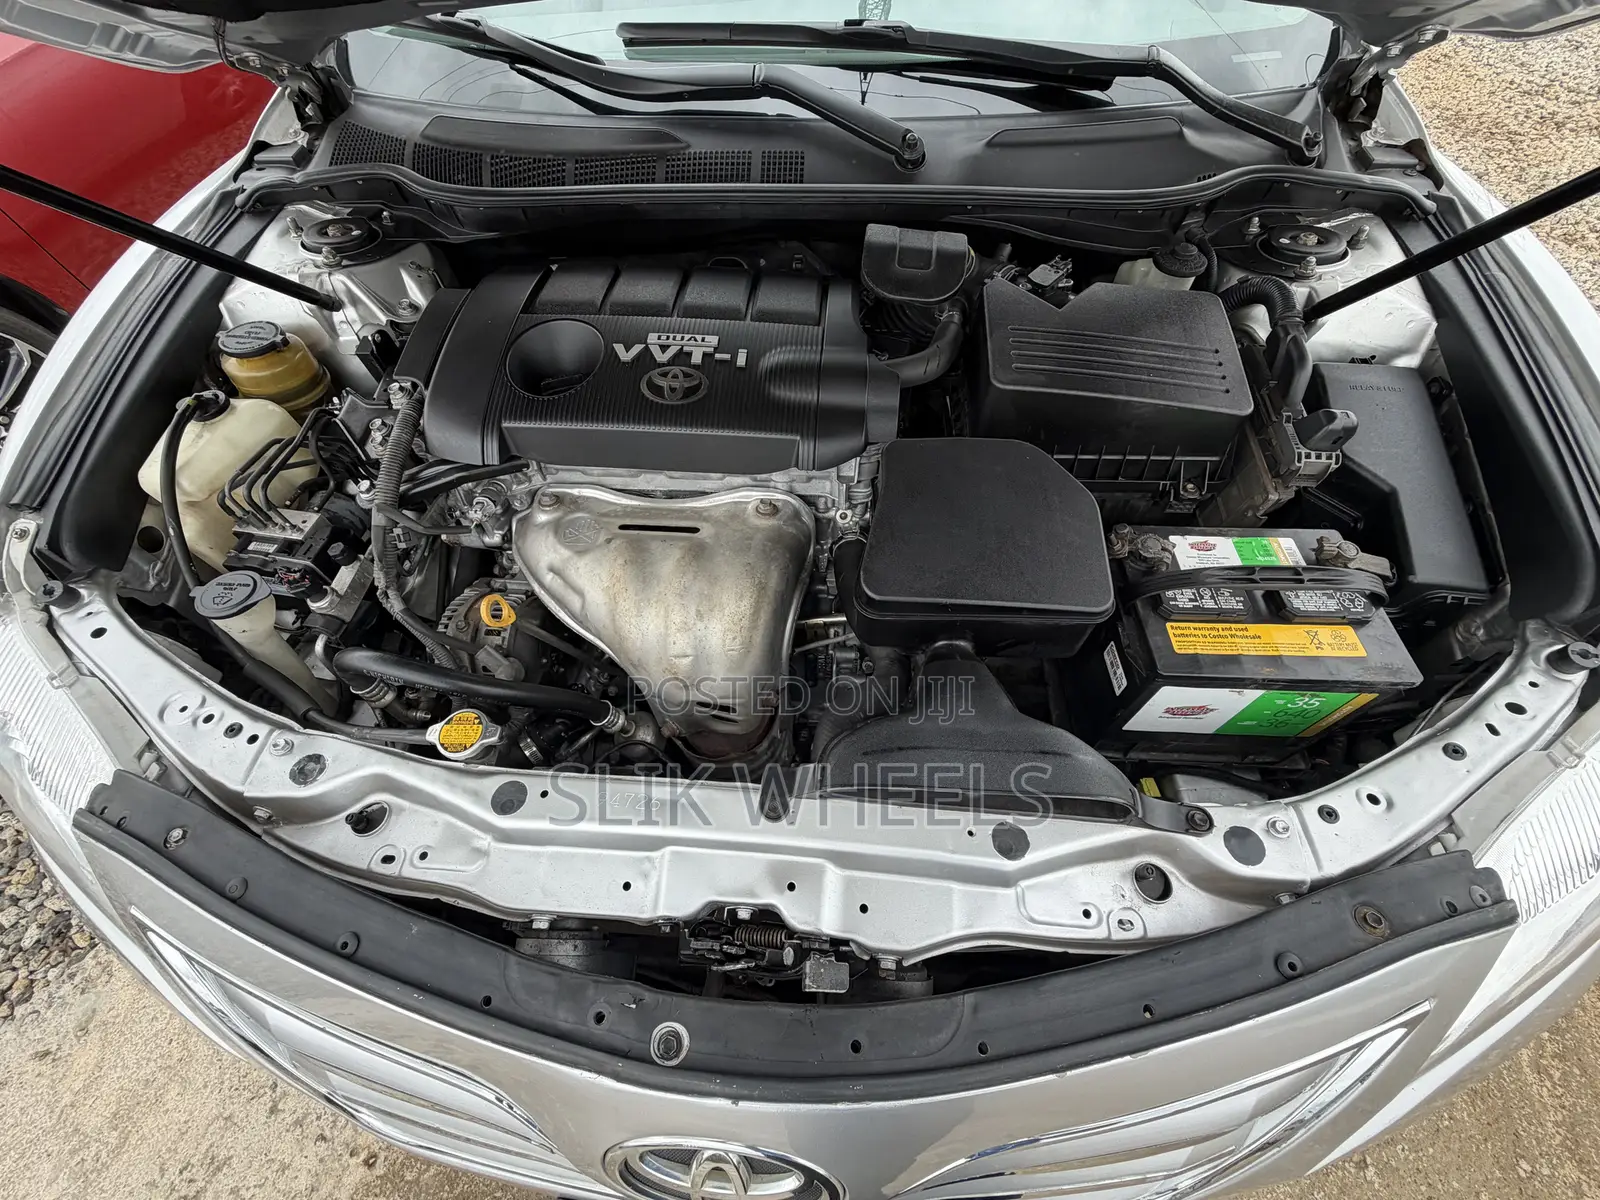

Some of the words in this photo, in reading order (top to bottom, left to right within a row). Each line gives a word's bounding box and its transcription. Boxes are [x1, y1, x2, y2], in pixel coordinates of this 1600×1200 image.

[657, 334, 712, 344] DUAL
[612, 342, 748, 368] VVT-i
[1170, 624, 1192, 632] Return
[1287, 697, 1327, 709] 35
[1273, 708, 1321, 719] 640
